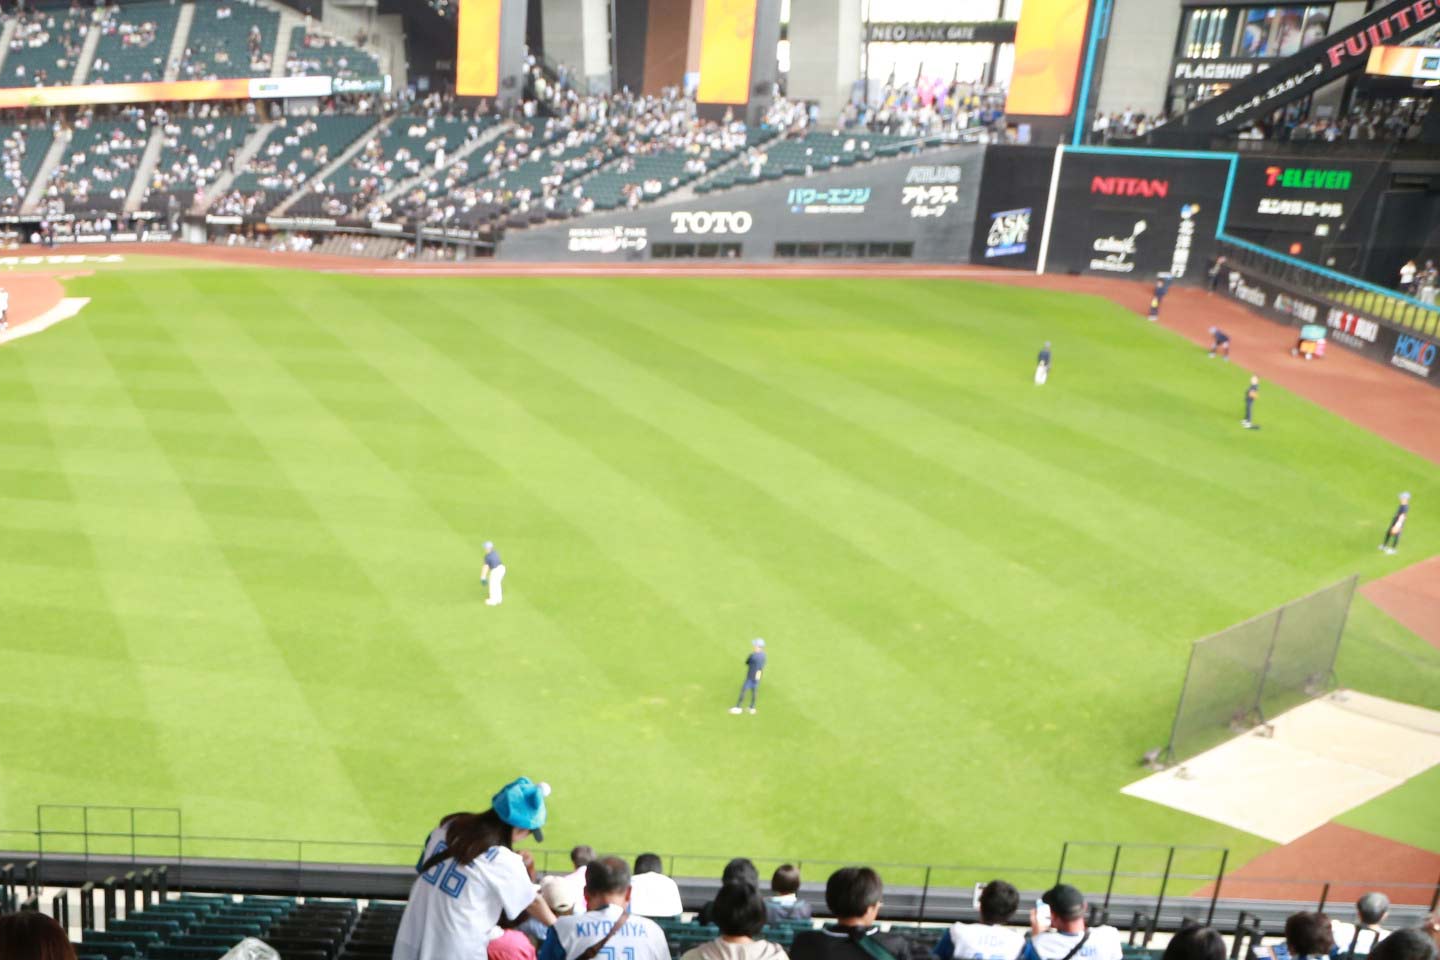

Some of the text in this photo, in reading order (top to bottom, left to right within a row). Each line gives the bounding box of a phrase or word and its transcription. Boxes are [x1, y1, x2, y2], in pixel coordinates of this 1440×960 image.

[1326, 0, 1440, 68] FUJITE
[1175, 62, 1253, 79] FLAGSHIP
[1090, 176, 1168, 198] NITTAN
[670, 211, 753, 234] TOTO
